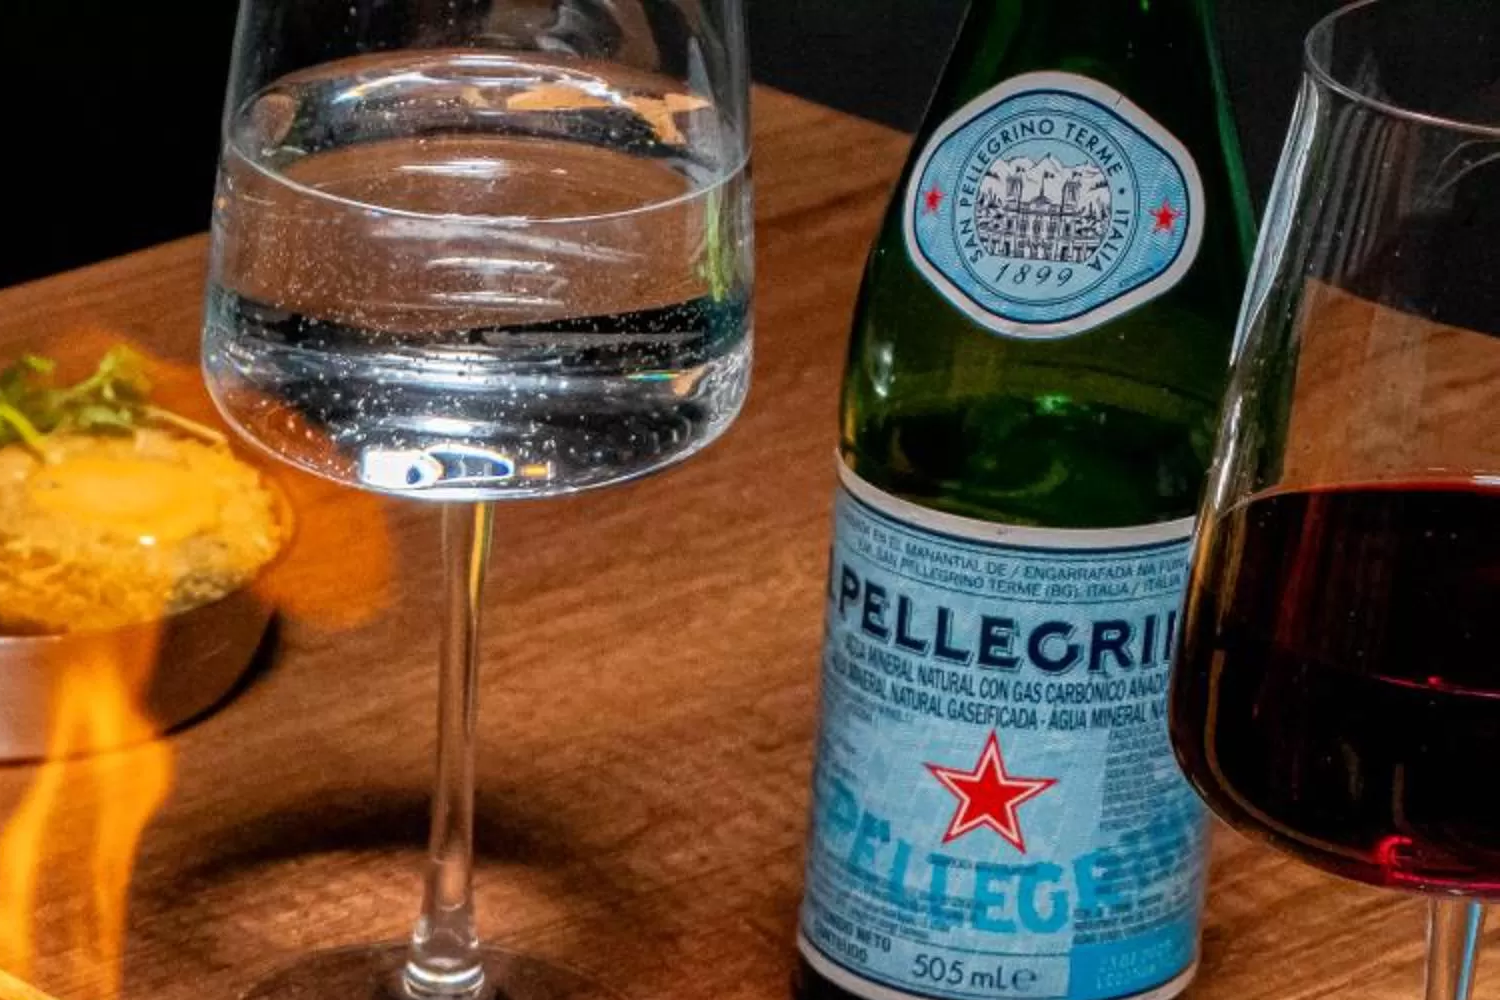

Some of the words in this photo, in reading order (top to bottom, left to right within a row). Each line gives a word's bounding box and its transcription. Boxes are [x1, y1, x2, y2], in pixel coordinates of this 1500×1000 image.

[959, 118, 1055, 207] PELLEGRINO
[1065, 121, 1123, 177] TERME
[959, 219, 983, 263] SAN
[1087, 209, 1131, 272] ITALIA
[994, 262, 1074, 287] 1899
[900, 557, 985, 589] PELLEGRINO
[989, 579, 1042, 596] TERME
[905, 542, 982, 573] MANANTIAL
[986, 561, 1008, 577] DE
[1024, 563, 1133, 582] ENGARRAFADA
[891, 680, 945, 718] NATURAL
[947, 697, 1038, 729] GASEIFICADA
[917, 662, 976, 697] NATURAL
[979, 674, 1010, 699] CON
[1012, 680, 1043, 704] GAS
[911, 953, 964, 985] 505
